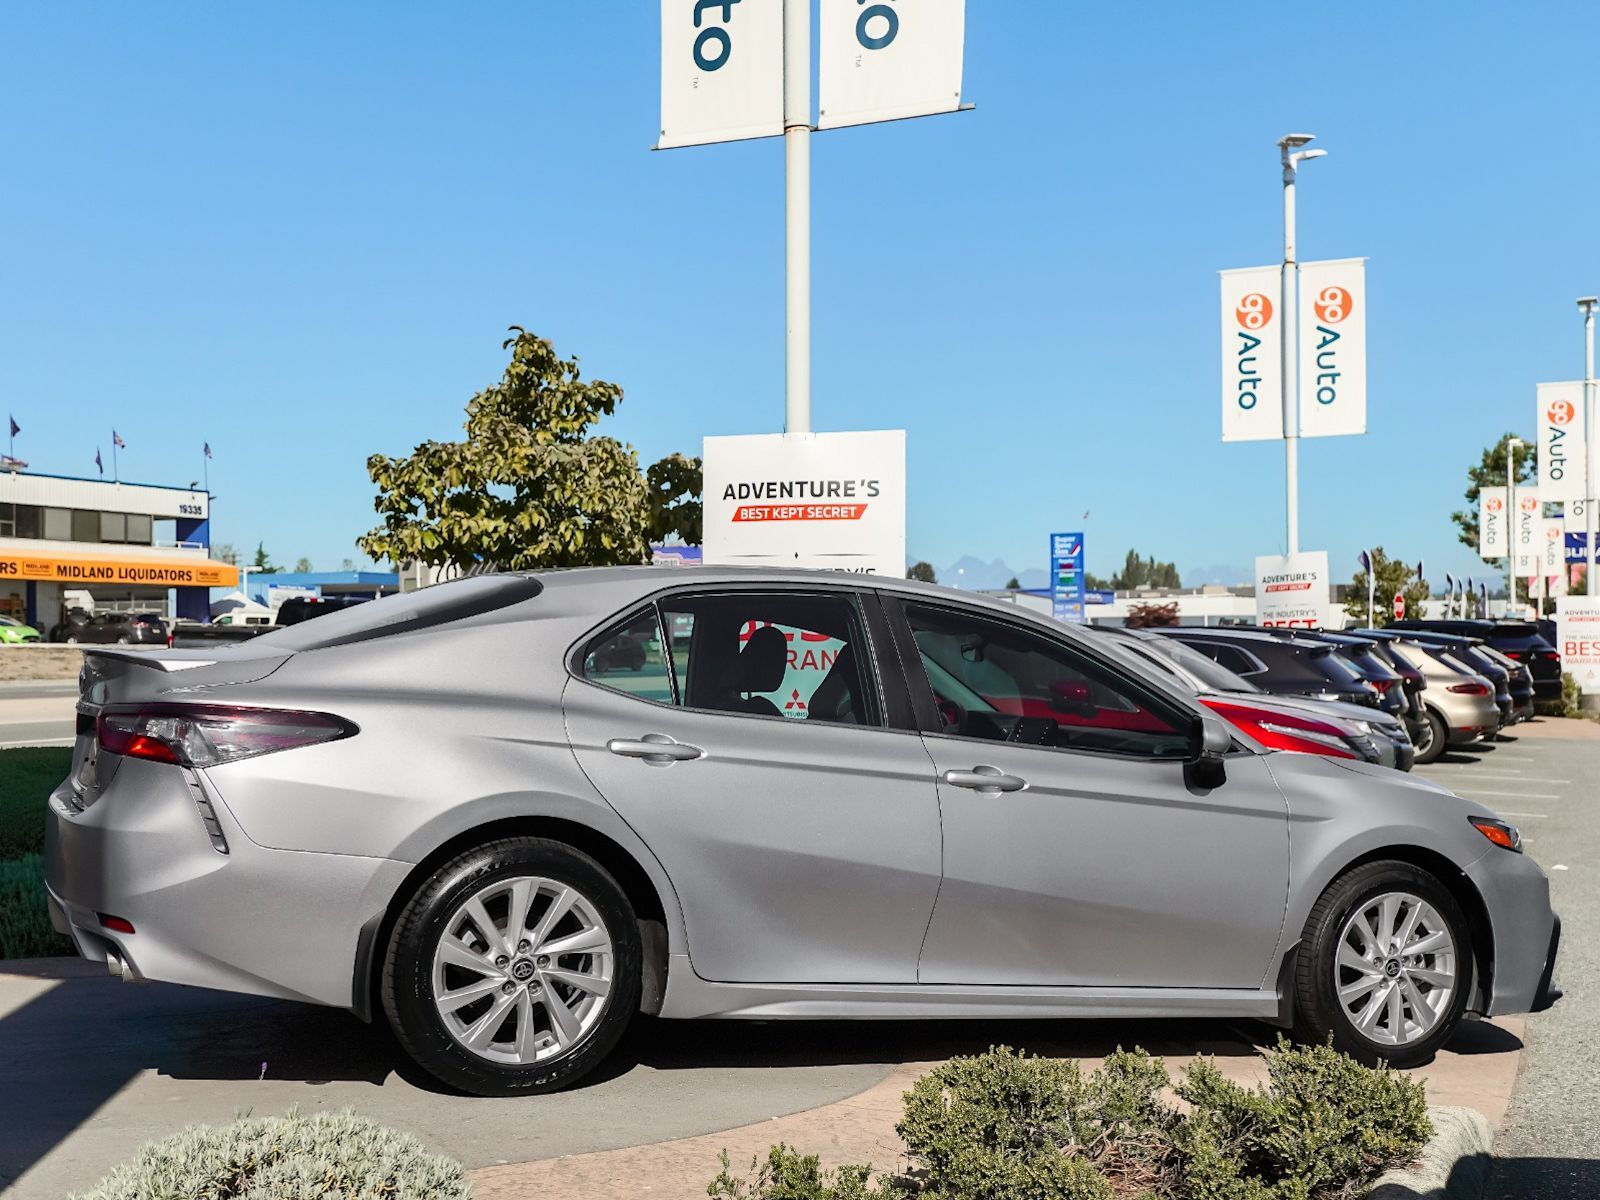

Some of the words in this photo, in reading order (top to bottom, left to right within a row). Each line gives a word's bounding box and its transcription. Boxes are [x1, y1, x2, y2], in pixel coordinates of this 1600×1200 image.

[1238, 332, 1262, 410] Auto
[1316, 325, 1341, 405] Auto
[1549, 427, 1567, 481] Auto
[723, 479, 880, 501] ADVENTURE'S
[740, 507, 769, 519] BEST
[772, 506, 804, 519] KEPT
[807, 505, 857, 518] SECRET
[56, 565, 114, 579] MIDLAND
[118, 567, 192, 582] LIQUIDATORS
[1262, 572, 1317, 584] ADVENTURE'S
[1275, 609, 1317, 618] INDUSTRY'S
